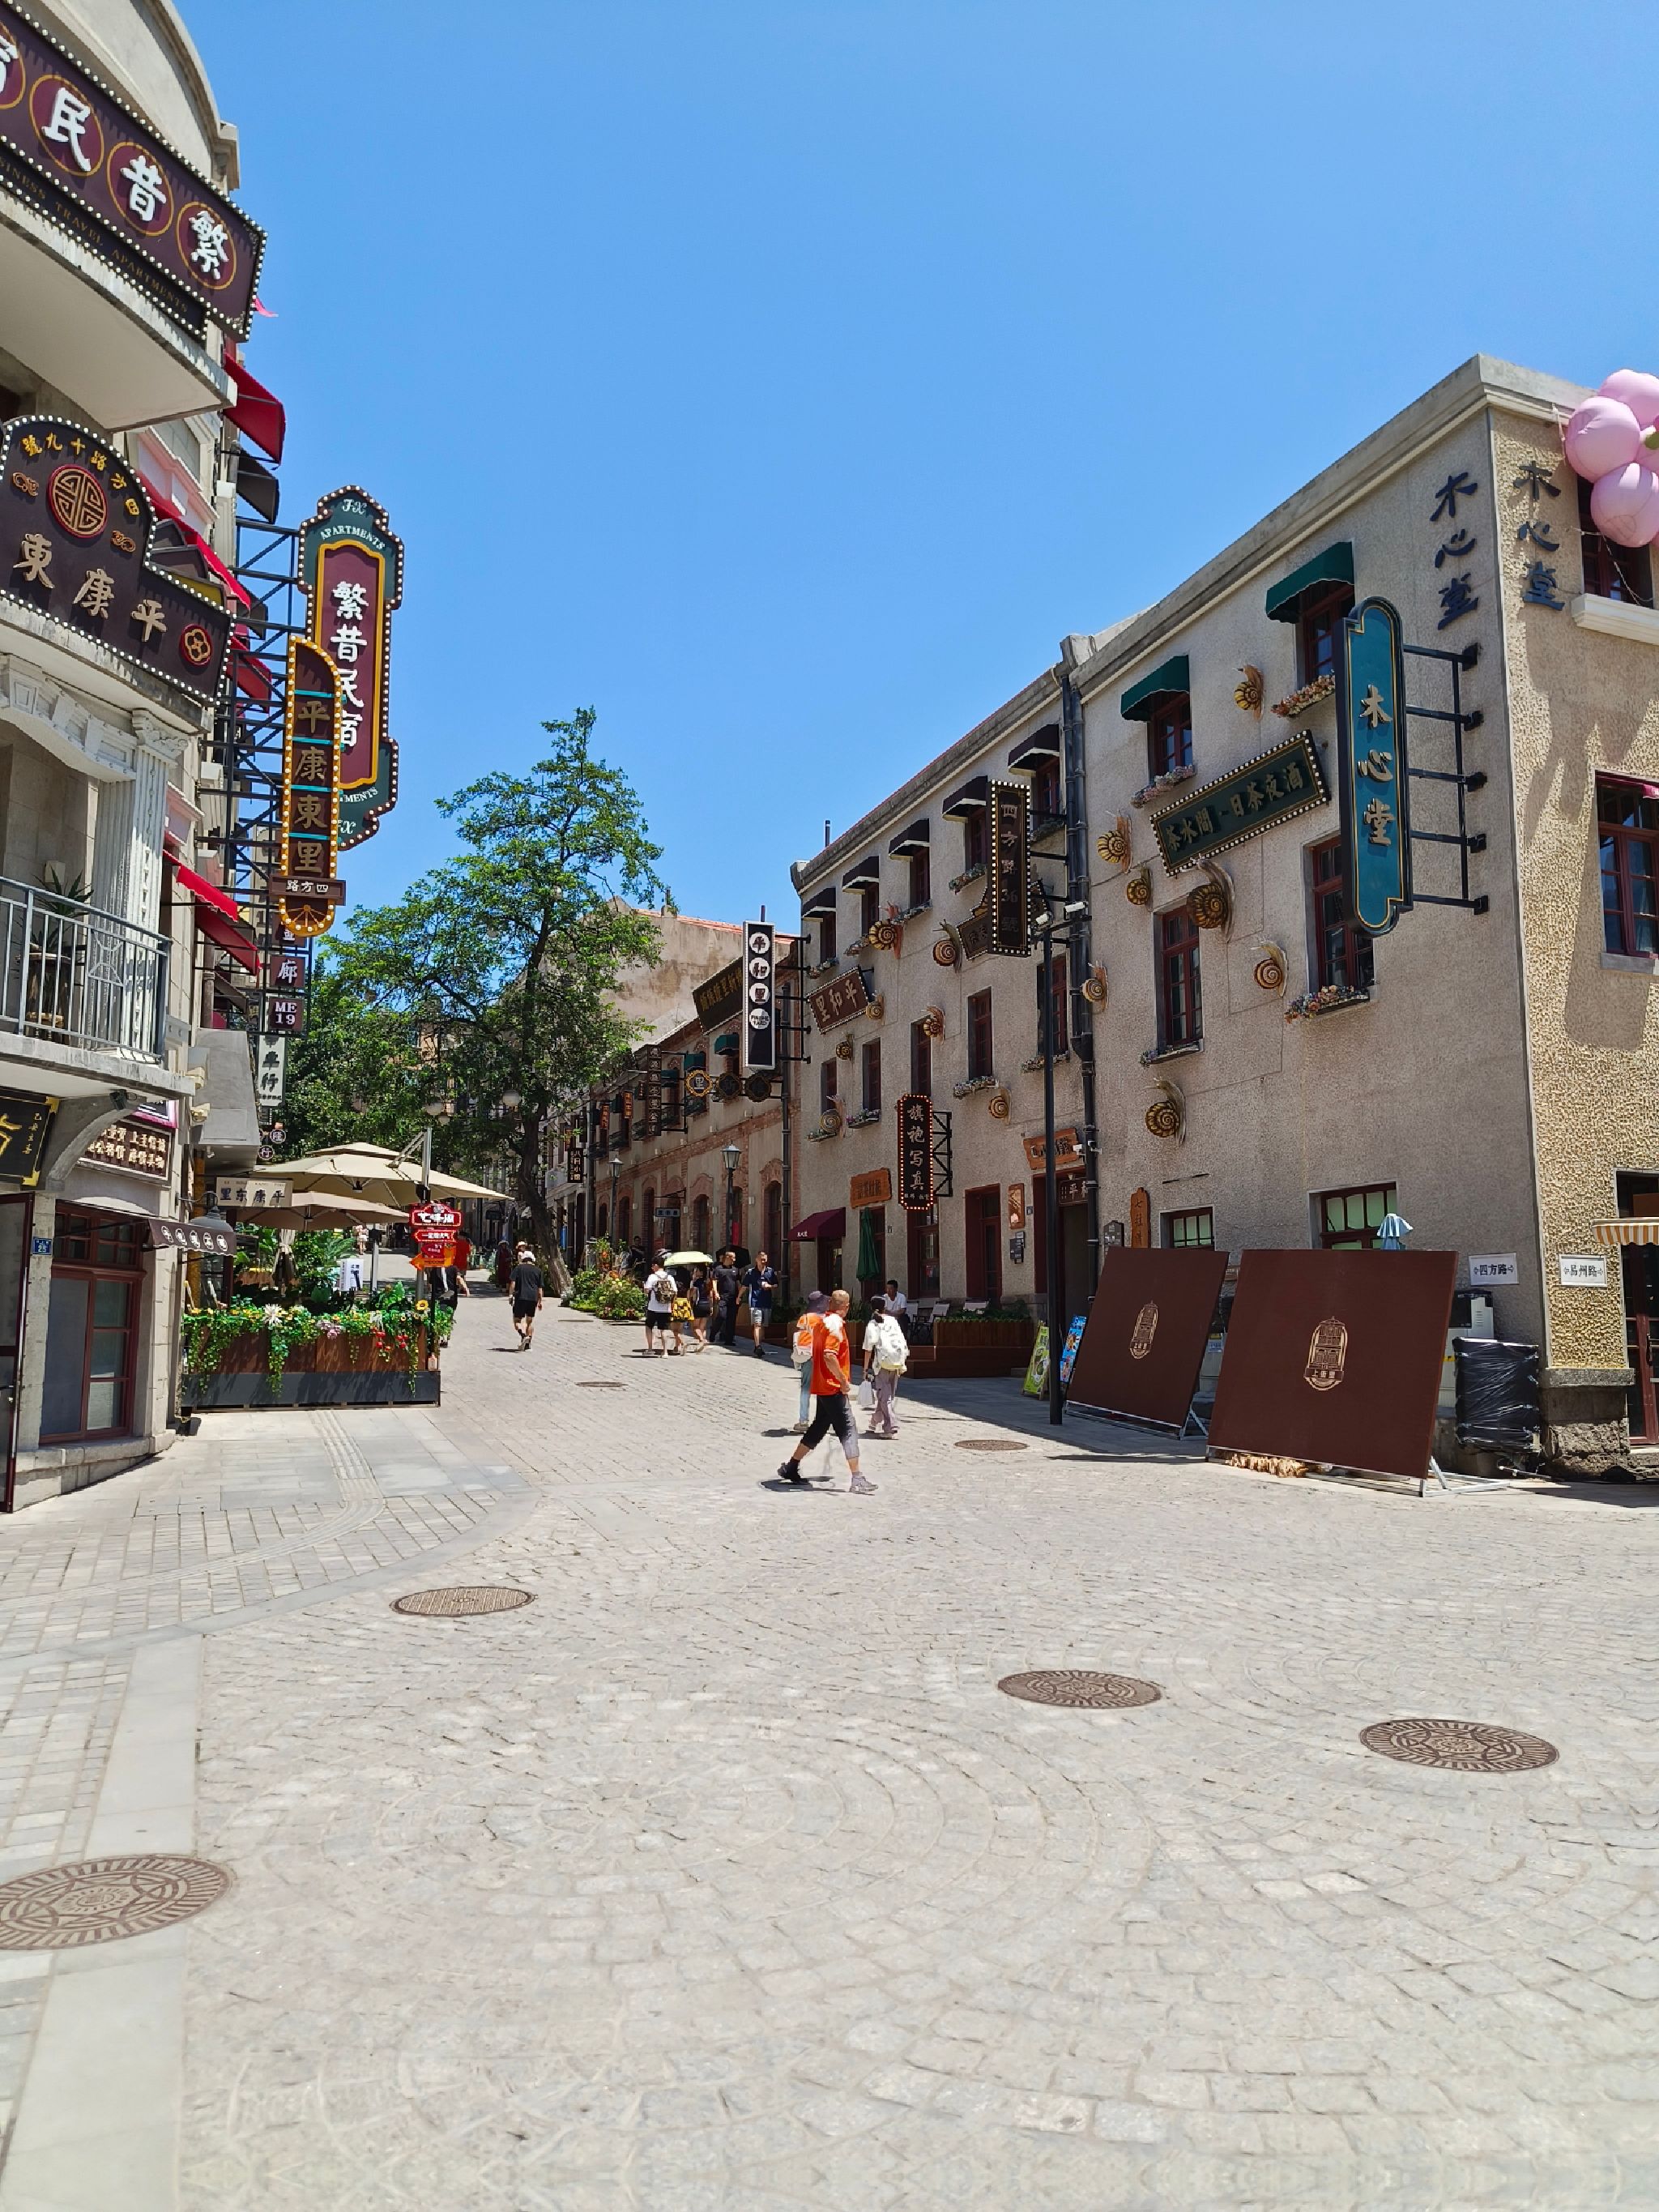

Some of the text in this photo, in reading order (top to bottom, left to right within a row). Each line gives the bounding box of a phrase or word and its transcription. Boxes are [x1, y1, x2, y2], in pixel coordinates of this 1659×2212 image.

[112, 249, 189, 313] APARTMENTS
[321, 525, 386, 550] APARTMENTS
[1430, 472, 1479, 630] 木心堂
[1513, 460, 1565, 611] 木心堂
[294, 700, 331, 875] 平康東里
[1358, 684, 1396, 848] 木心堂
[287, 879, 329, 893] 四方路
[753, 936, 768, 1002] 平和里
[815, 979, 858, 1023] 平和里
[275, 1001, 298, 1013] ME
[275, 1014, 296, 1025] 19
[907, 1104, 925, 1191] 旗袍写真
[1479, 1264, 1508, 1276] 四方路
